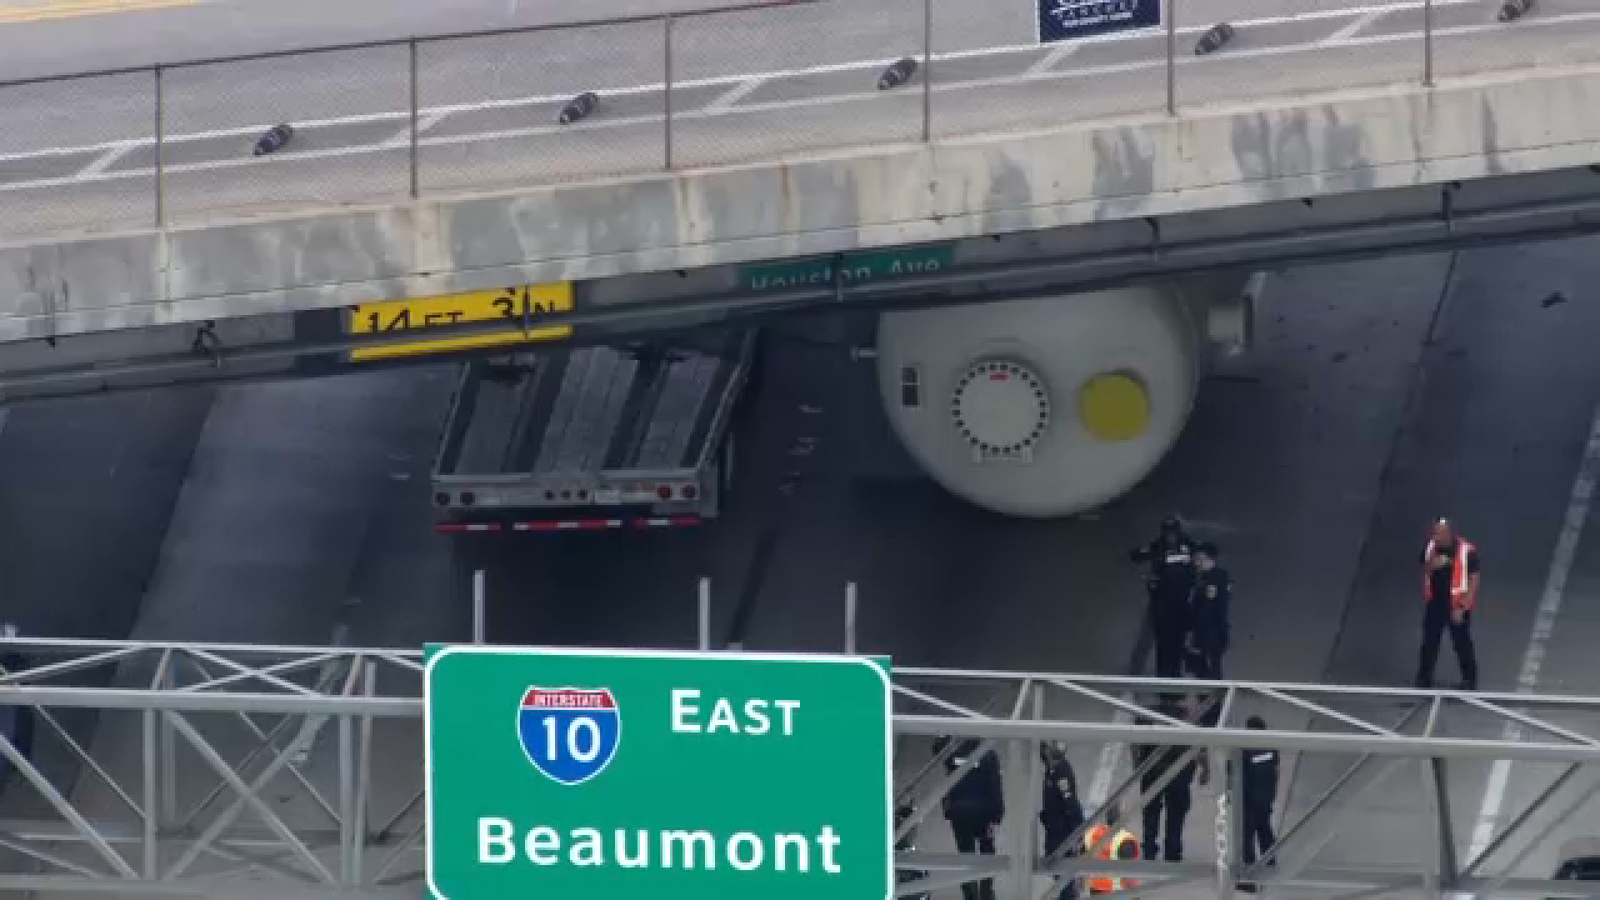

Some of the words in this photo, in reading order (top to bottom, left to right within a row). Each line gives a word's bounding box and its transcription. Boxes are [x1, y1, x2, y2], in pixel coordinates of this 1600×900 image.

[670, 688, 801, 736] EAST
[542, 715, 601, 763] 10
[476, 816, 842, 874] Beaumont
